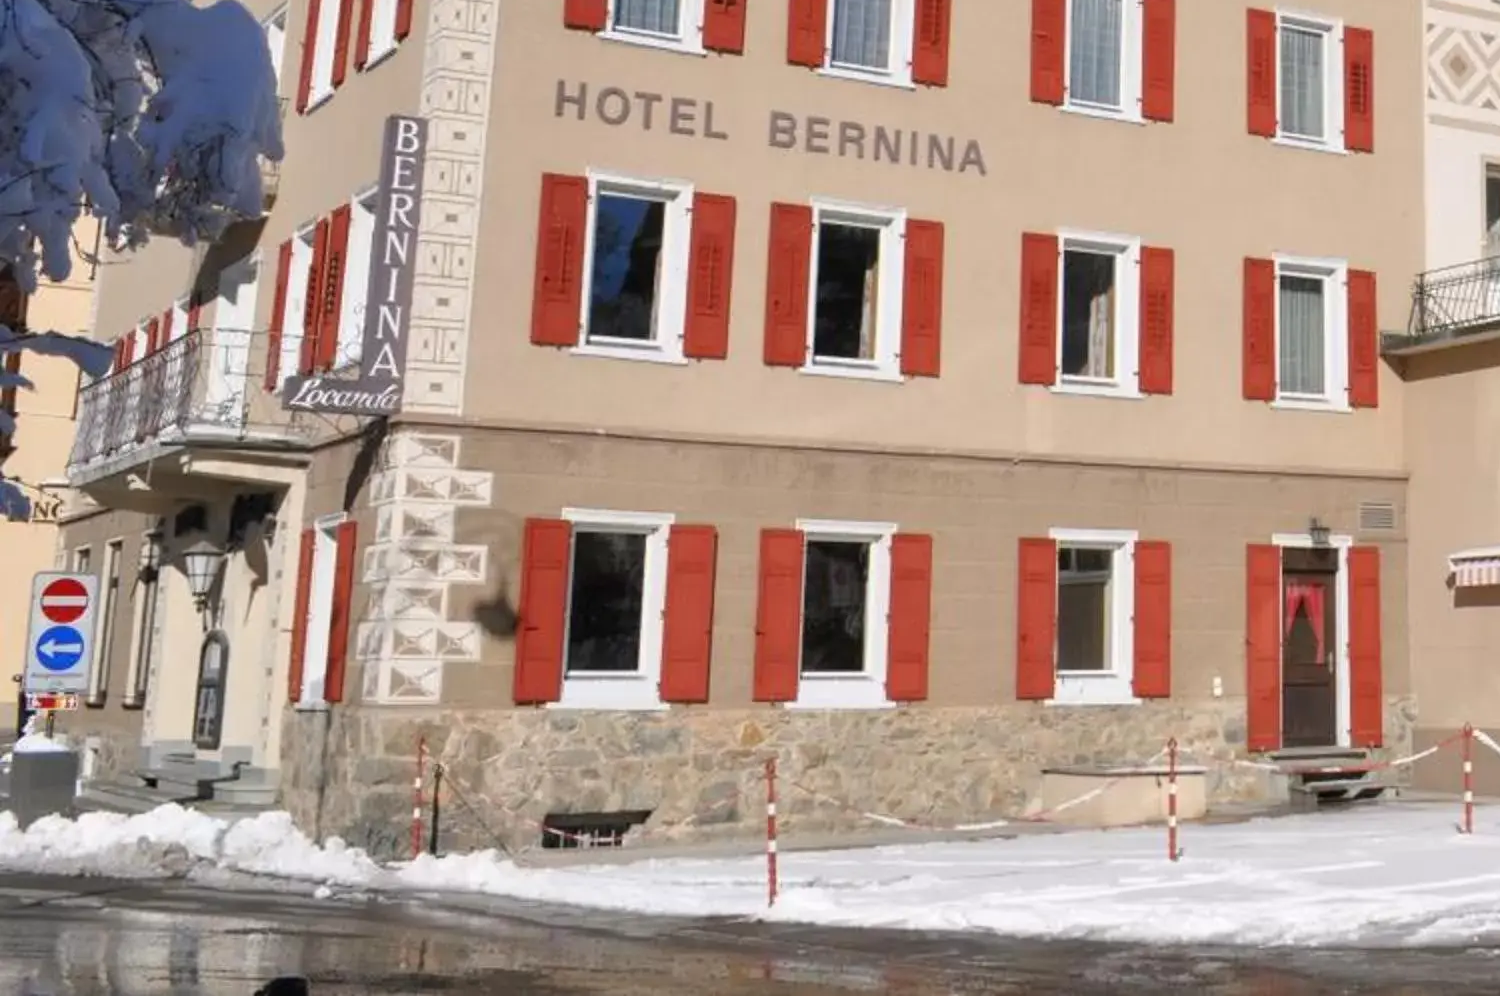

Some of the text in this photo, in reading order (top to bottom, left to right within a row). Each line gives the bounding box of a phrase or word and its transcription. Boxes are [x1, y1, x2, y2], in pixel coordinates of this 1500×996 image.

[555, 79, 987, 175] HOTEL BERNINA
[367, 118, 421, 378] BERNINA
[290, 377, 400, 408] Locanda
